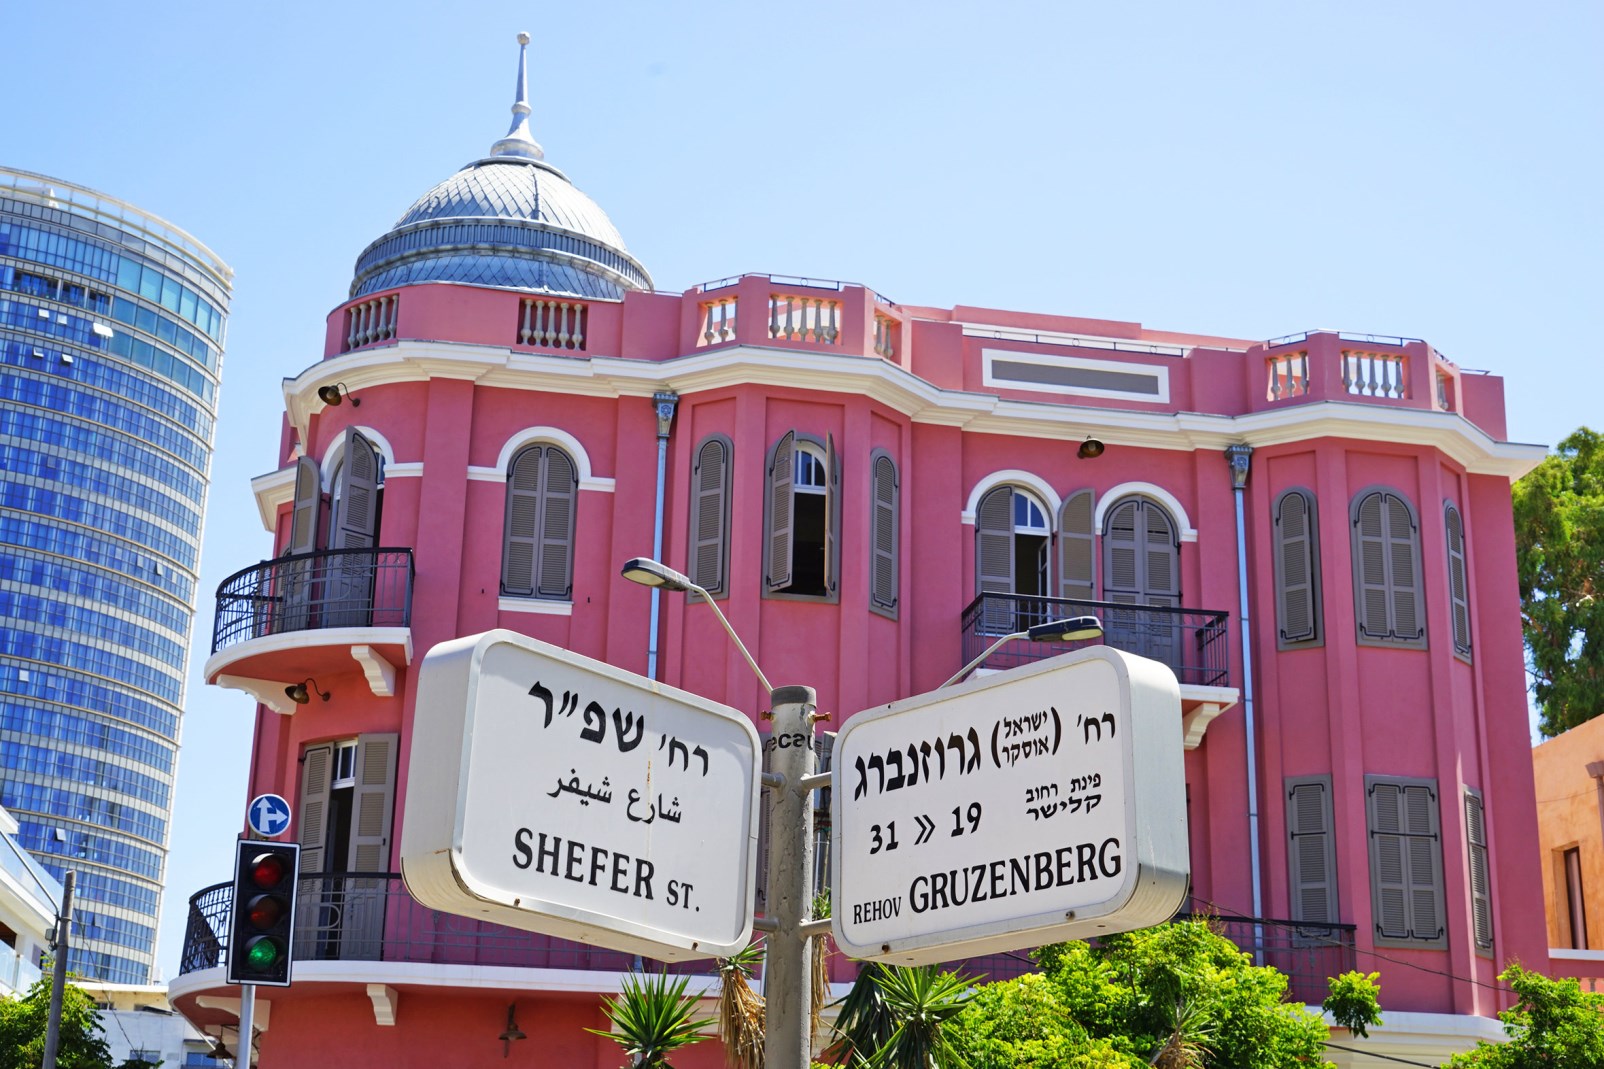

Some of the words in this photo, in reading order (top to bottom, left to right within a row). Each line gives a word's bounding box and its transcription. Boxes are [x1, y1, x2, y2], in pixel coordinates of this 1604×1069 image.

[854, 726, 982, 802] גרוזנברג
[1070, 772, 1102, 794] פינת
[546, 768, 612, 807] شيفر
[626, 788, 683, 826] شارع
[1025, 783, 1059, 804] רחוב
[1025, 793, 1102, 822] קלישר
[869, 820, 899, 855] 31
[950, 801, 982, 838] 19
[512, 827, 655, 901] SHEFER
[666, 879, 701, 913] ST.
[853, 896, 902, 925] REHOV
[909, 837, 1122, 914] GRUZENBERG
